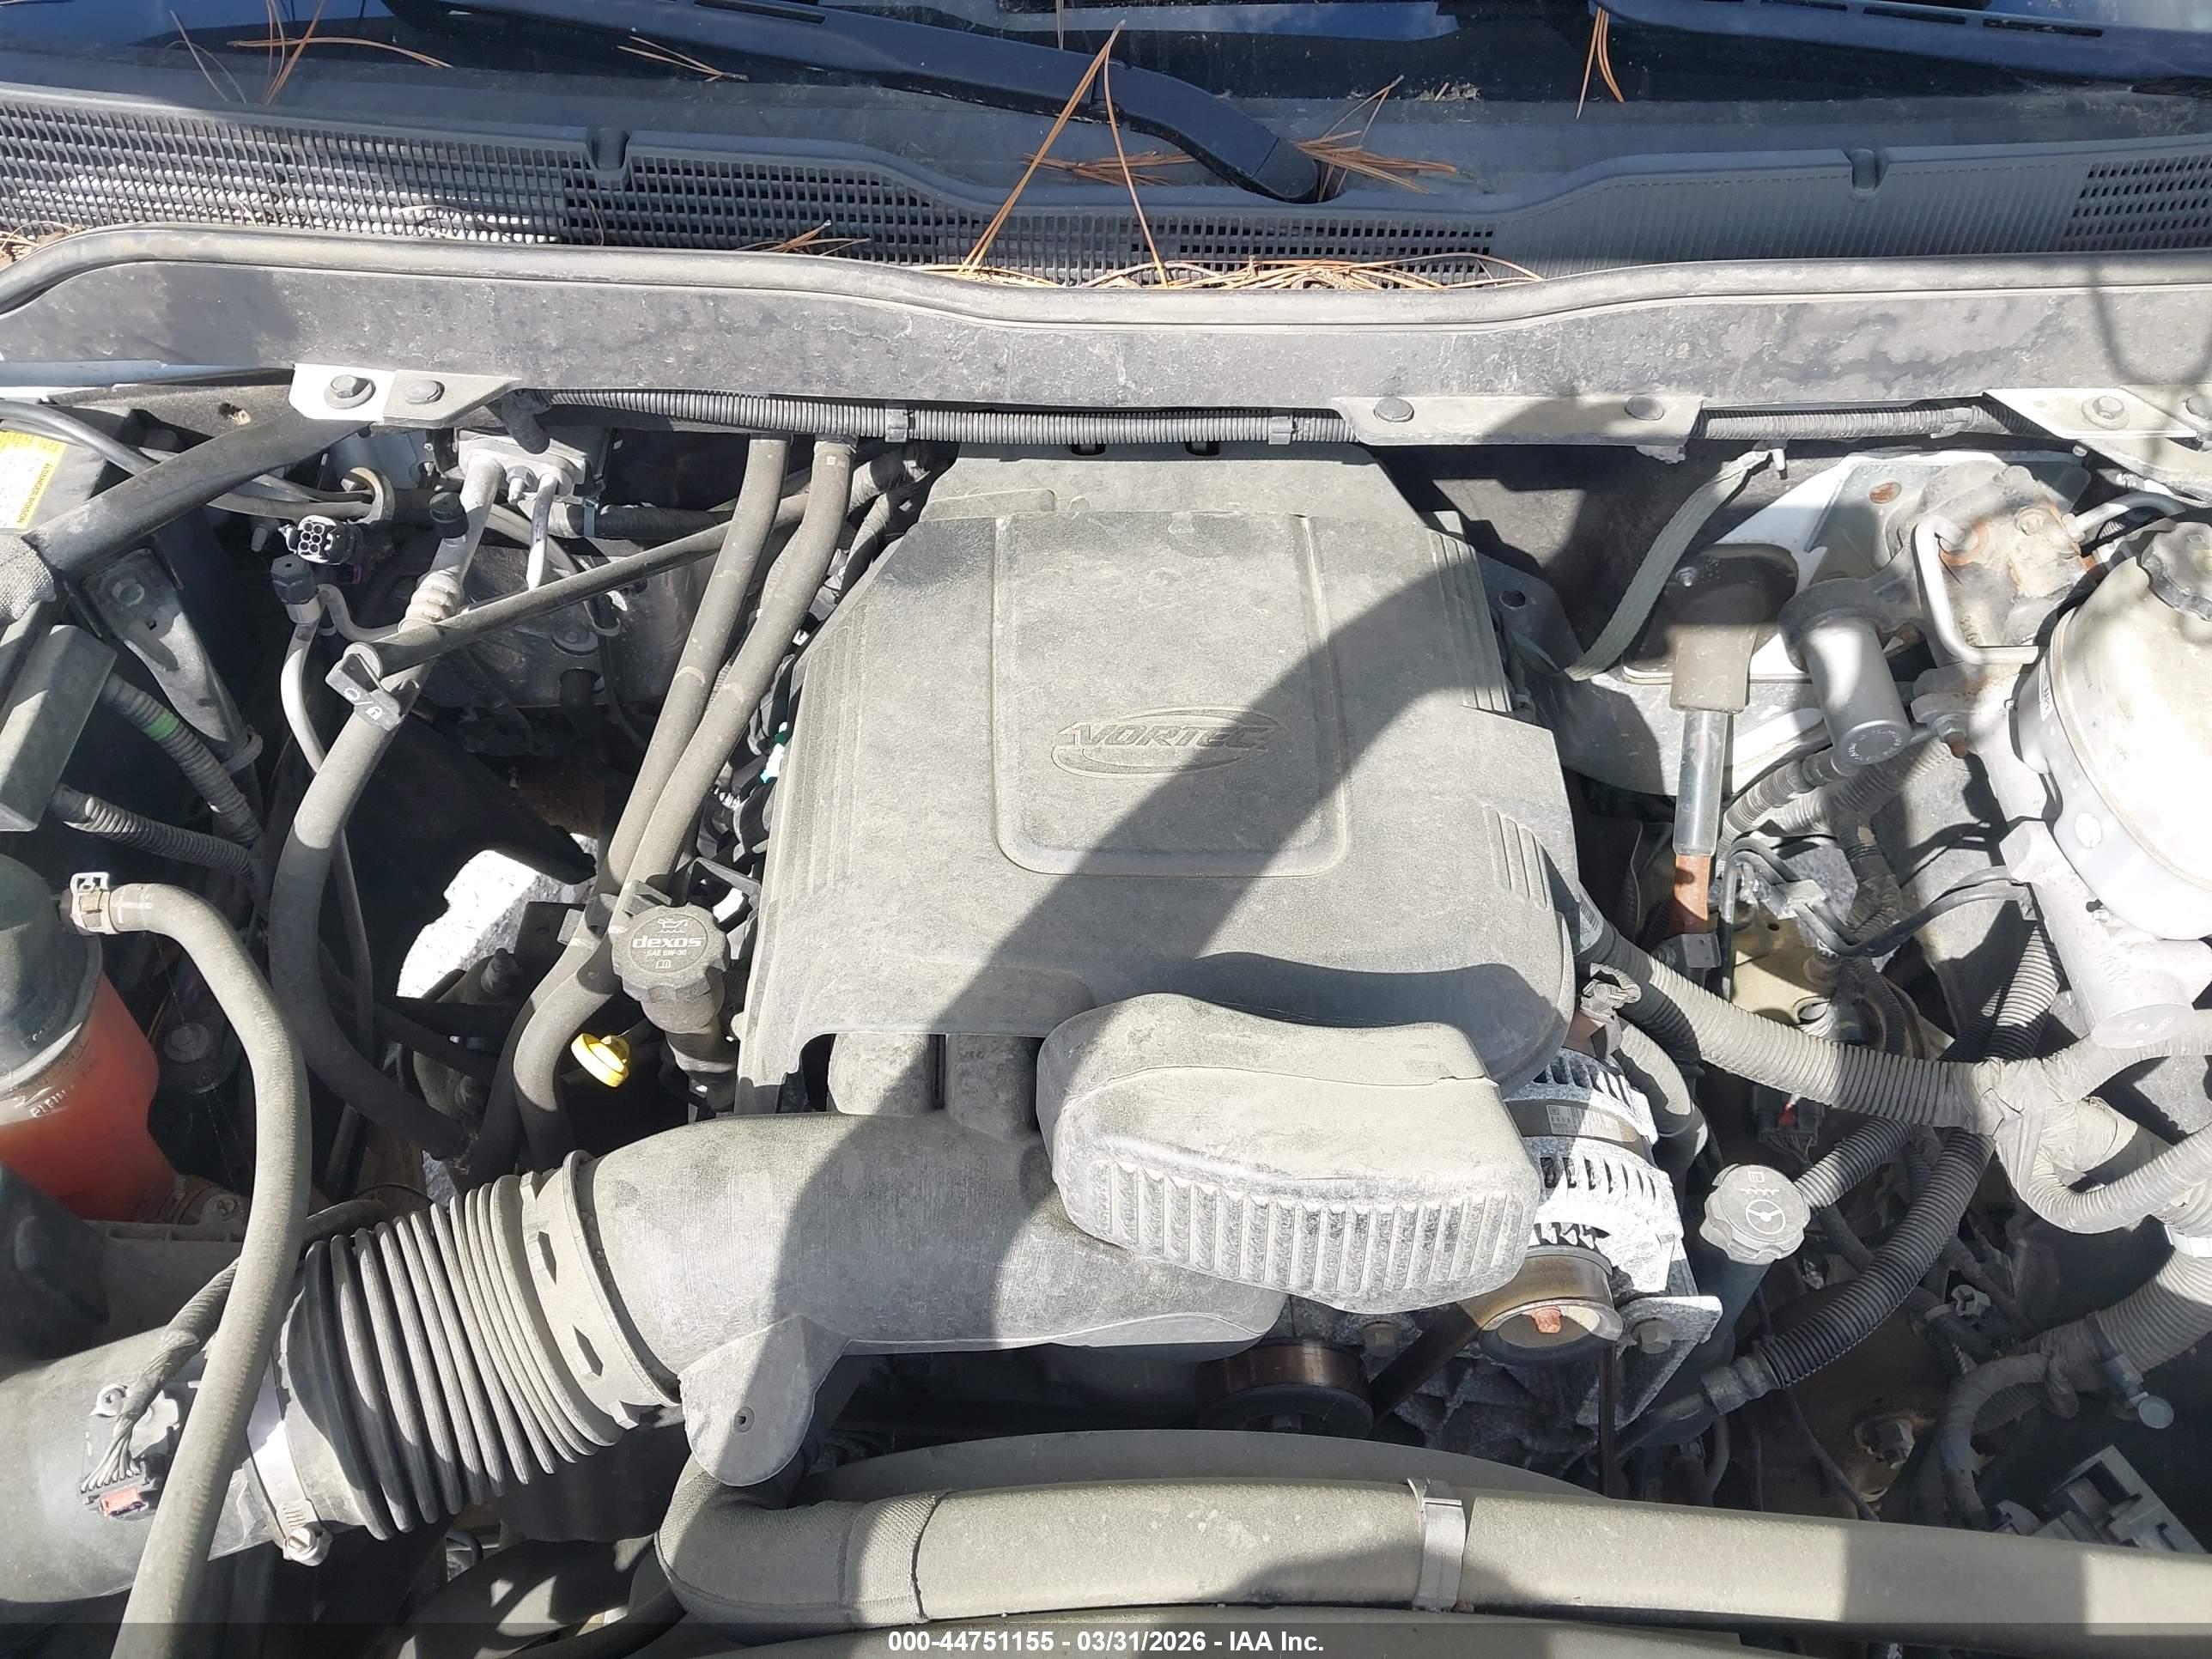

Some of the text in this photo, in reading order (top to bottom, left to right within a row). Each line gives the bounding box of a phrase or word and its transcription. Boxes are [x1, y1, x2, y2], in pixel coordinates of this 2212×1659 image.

[17, 497, 36, 523] POISON
[1073, 723, 1272, 747] VORTEC
[631, 935, 702, 948] dexos
